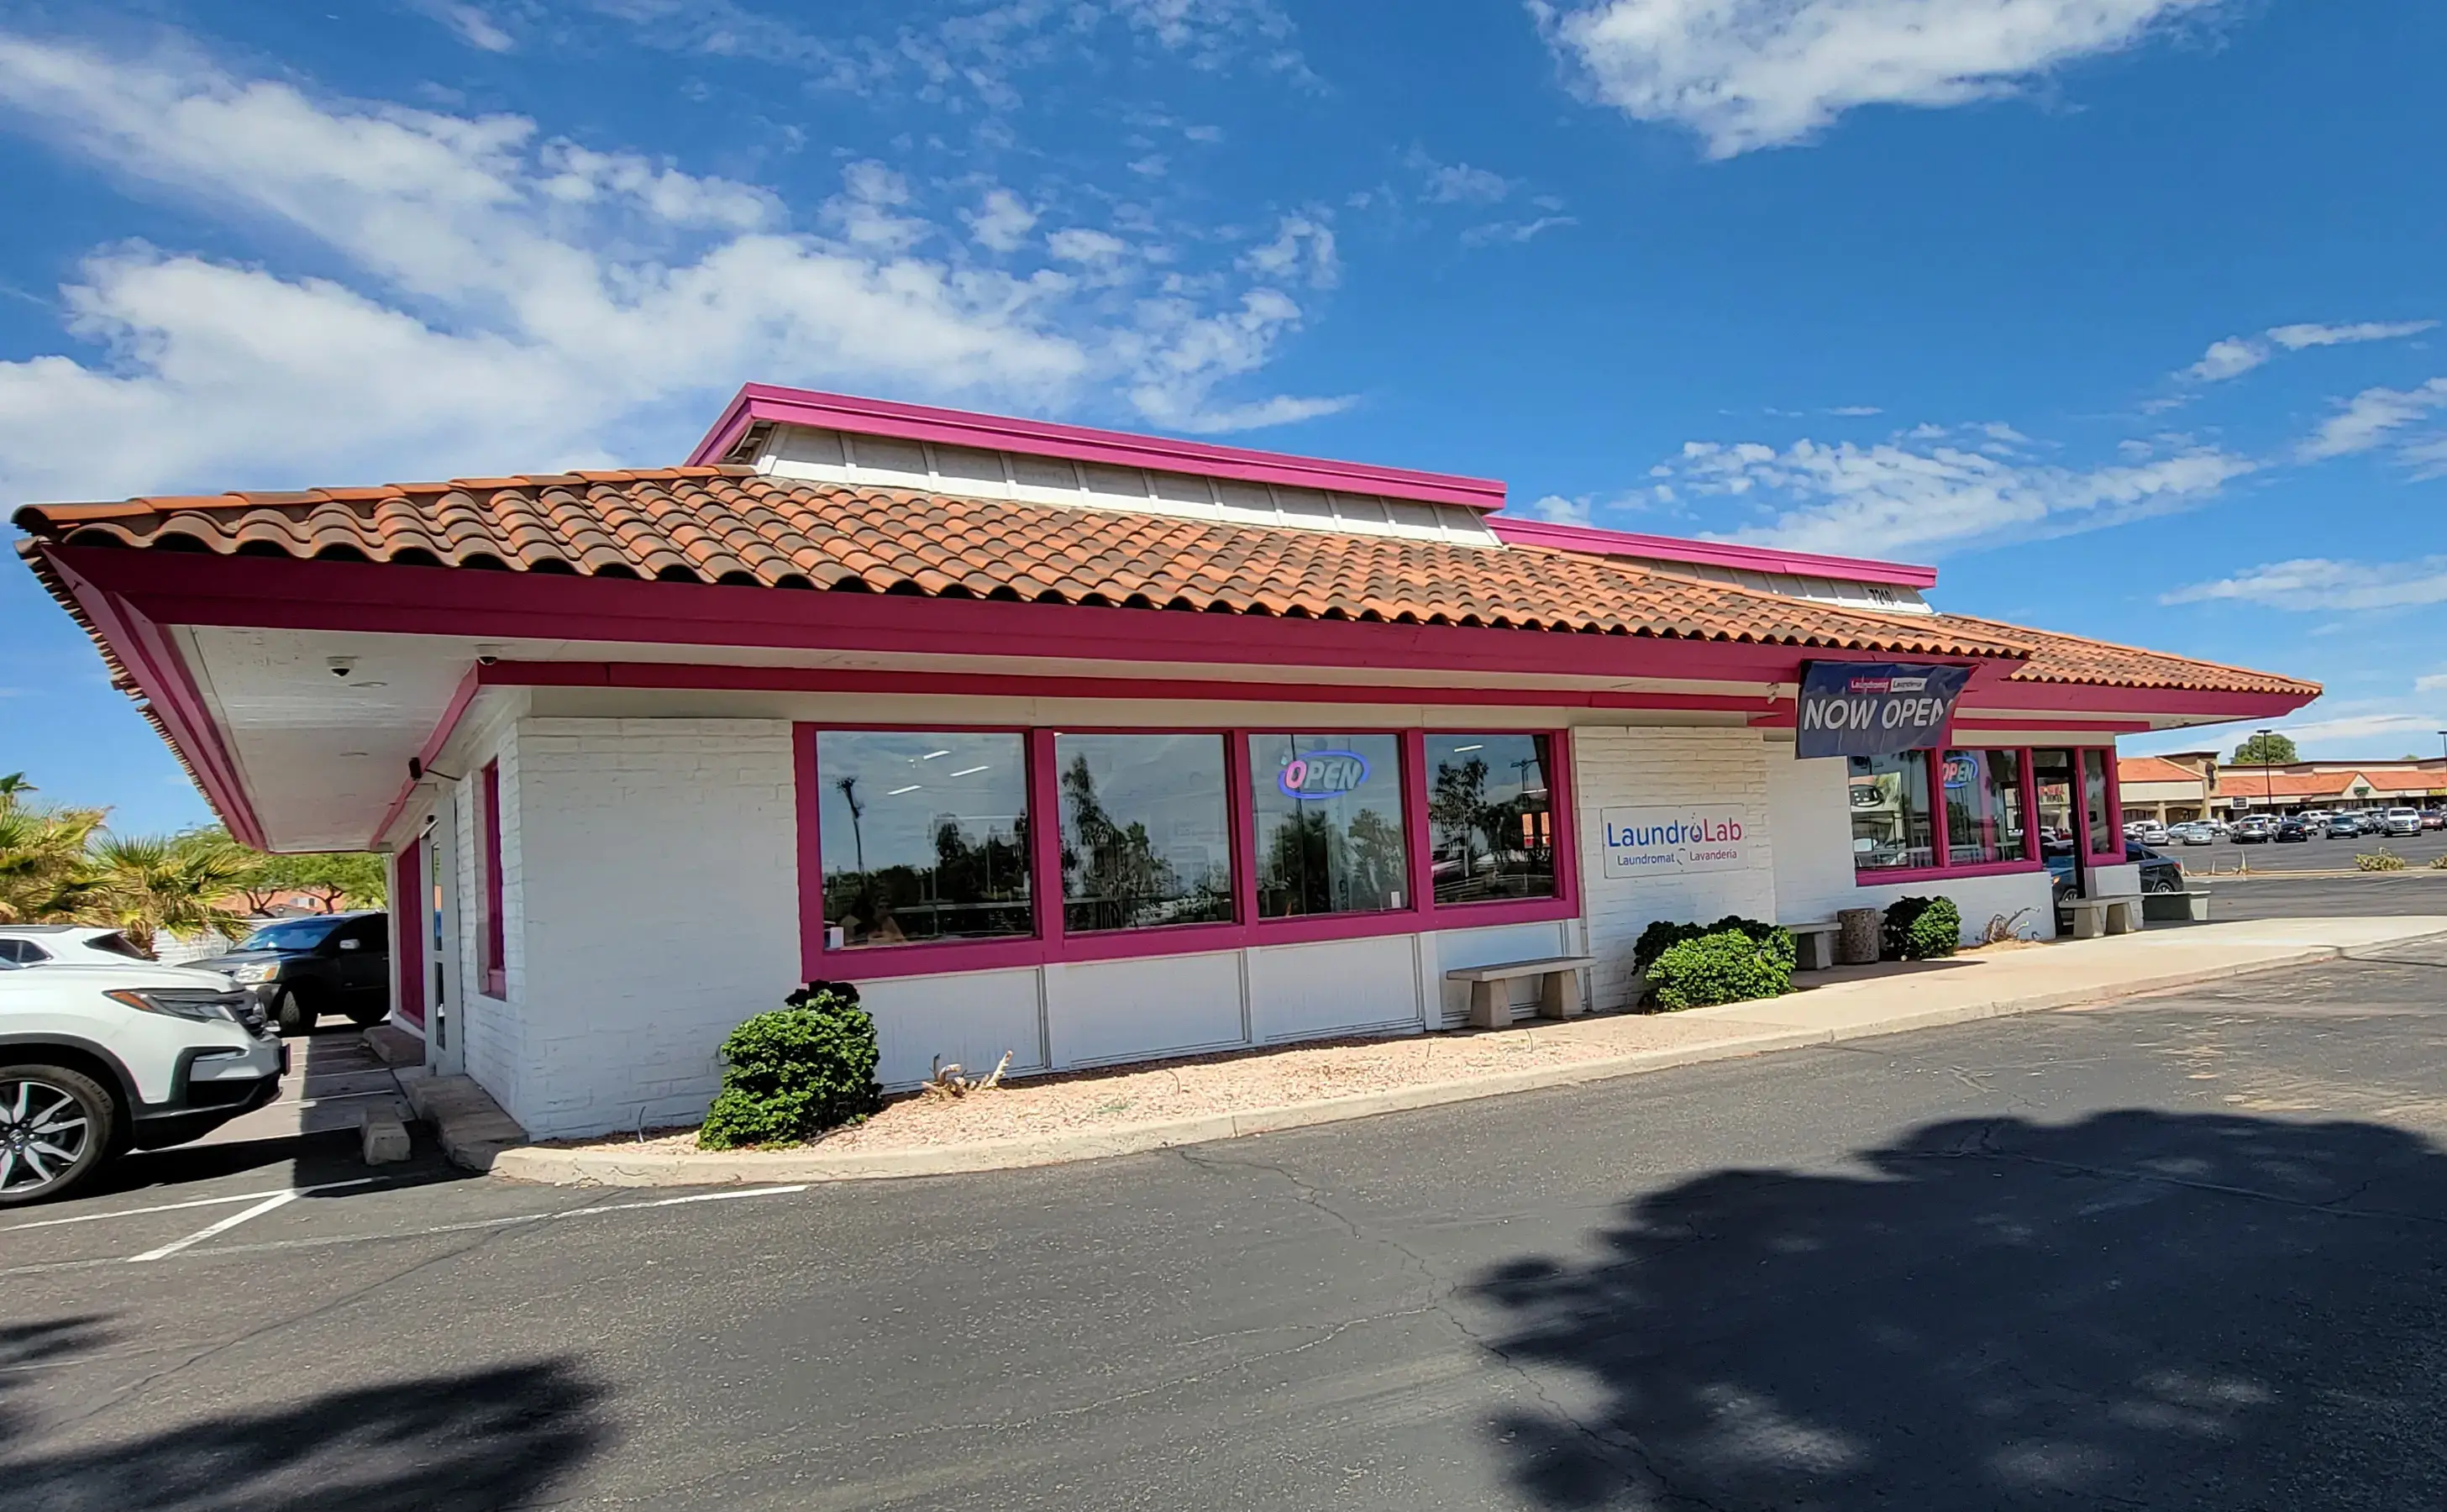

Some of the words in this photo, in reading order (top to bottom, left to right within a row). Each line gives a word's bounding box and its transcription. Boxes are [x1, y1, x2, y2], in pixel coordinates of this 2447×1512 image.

[1804, 698, 1877, 730] NOW
[1285, 759, 1361, 790] OPEN
[1607, 817, 1742, 848] LaundroLab
[1617, 853, 1676, 866] Laundromat
[1689, 848, 1737, 861] Lavandería
